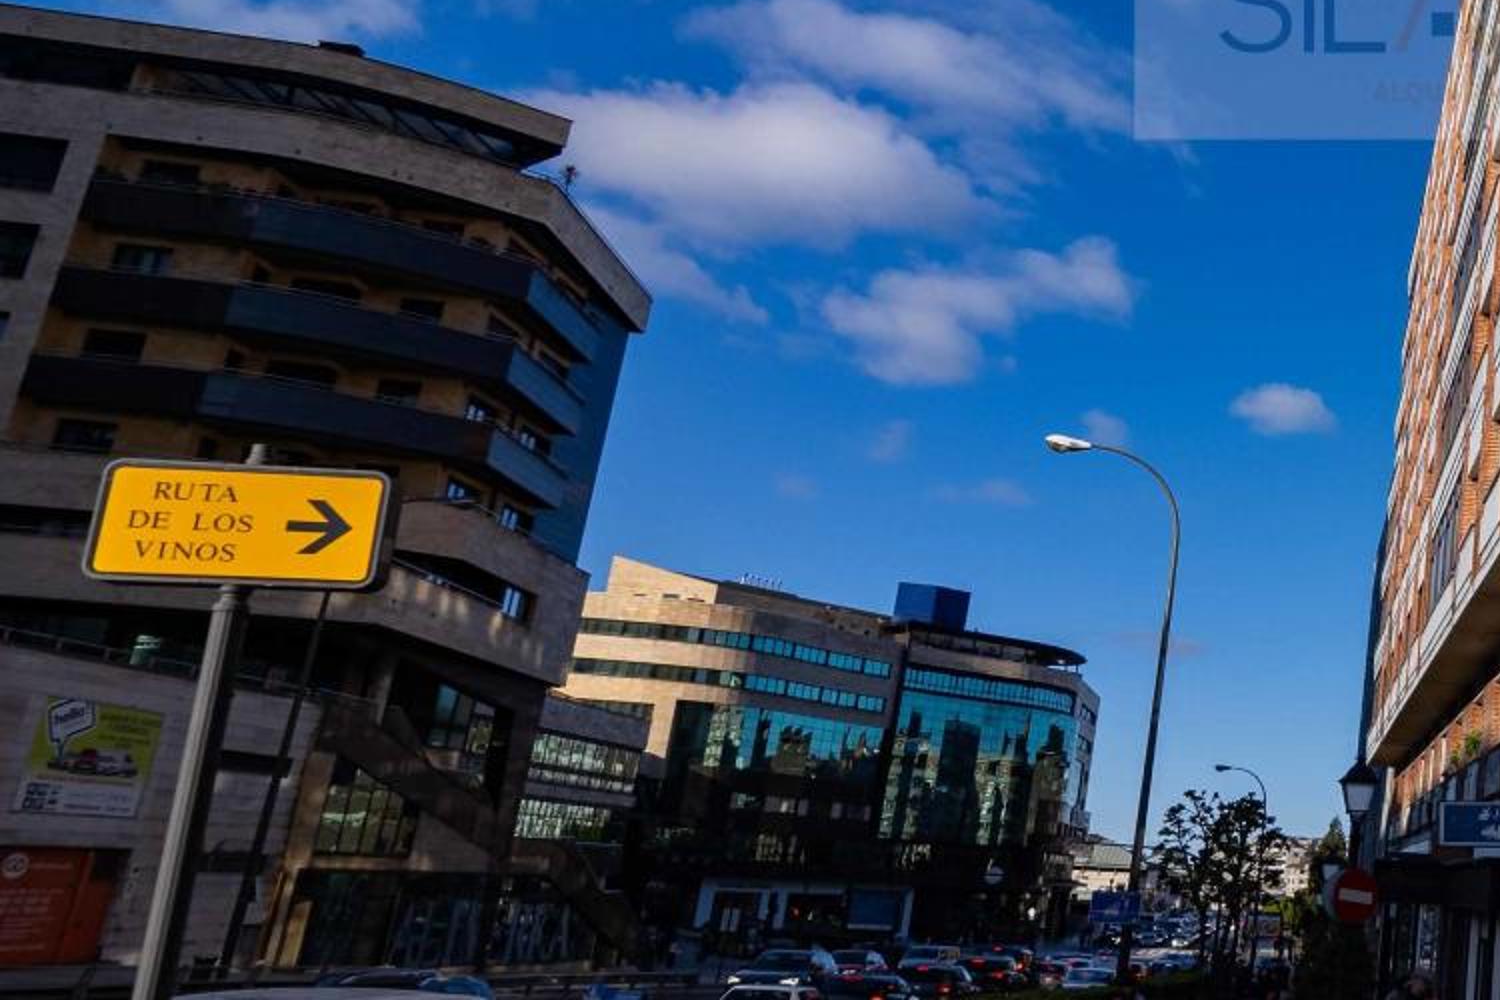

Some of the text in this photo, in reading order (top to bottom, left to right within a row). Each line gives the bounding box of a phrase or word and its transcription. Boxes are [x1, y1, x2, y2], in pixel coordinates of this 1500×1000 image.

[153, 480, 239, 503] RUTA
[127, 509, 254, 533] DE LOS
[134, 540, 236, 562] VINOS
